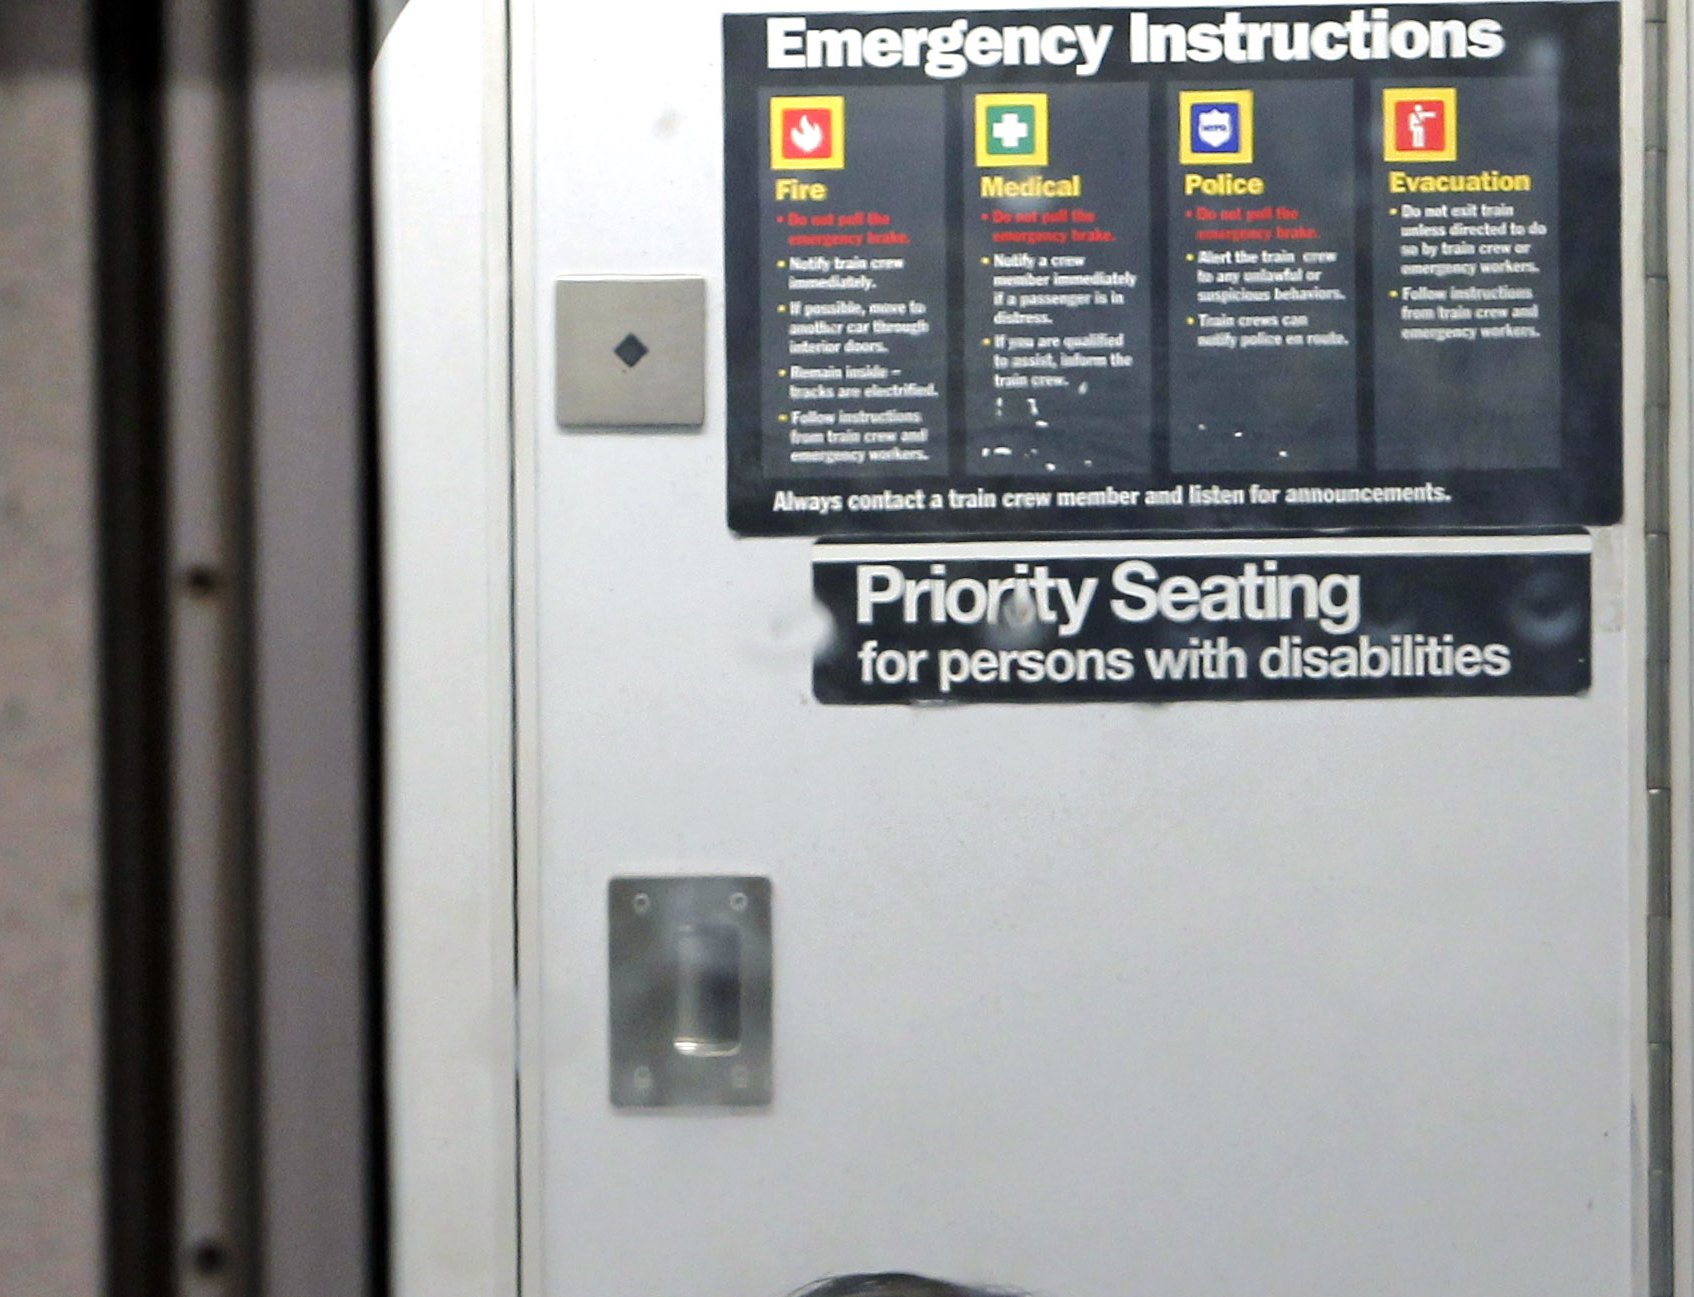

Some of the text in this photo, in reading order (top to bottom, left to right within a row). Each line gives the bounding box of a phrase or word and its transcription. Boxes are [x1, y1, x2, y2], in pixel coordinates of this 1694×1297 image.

[766, 8, 1506, 79] Emergency Instructions
[774, 178, 828, 201] Fire
[980, 175, 1082, 198] Medical
[1184, 173, 1265, 196] Police
[1389, 170, 1531, 193] Evacuation
[1401, 203, 1514, 218] Do not exit train
[1401, 221, 1547, 237] unless directed to do
[1198, 249, 1337, 264] Alert the train crew
[1400, 241, 1531, 258] so by train crew or
[789, 255, 904, 272] Notify train crew
[993, 252, 1086, 269] Notify a crew
[1400, 259, 1540, 277] emergency workers.
[788, 275, 877, 291] immediately.
[993, 270, 1137, 287] member immediately
[1197, 268, 1322, 284] to any unlawful or
[1006, 294, 1017, 306] a
[1019, 293, 1091, 308] passenger
[1094, 290, 1108, 304] is
[1110, 290, 1124, 304] in
[1197, 286, 1346, 304] suspicious behaviors.
[1402, 285, 1534, 300] Follow instructions
[789, 300, 927, 318] If possible, move to
[993, 310, 1053, 324] distress.
[1401, 304, 1538, 320] from train crew and
[788, 320, 930, 336] another car through
[1198, 313, 1308, 328] Train crews can
[789, 339, 889, 354] interior doors.
[994, 332, 1124, 351] If you are qualified
[1197, 331, 1349, 348] notify police en route.
[993, 352, 1133, 369] to assist, inform the
[790, 365, 843, 380] Remain
[845, 364, 888, 379] inside
[993, 373, 1069, 388] train crew.
[789, 383, 938, 399] tracks are electrified.
[790, 409, 923, 425] Follow instructions
[789, 428, 928, 444] from train crew and
[773, 482, 1451, 514] Always contact a train crew member and listen for announcements.
[857, 560, 1361, 635] Priority Seating
[858, 634, 1511, 692] for persons with disabilities
